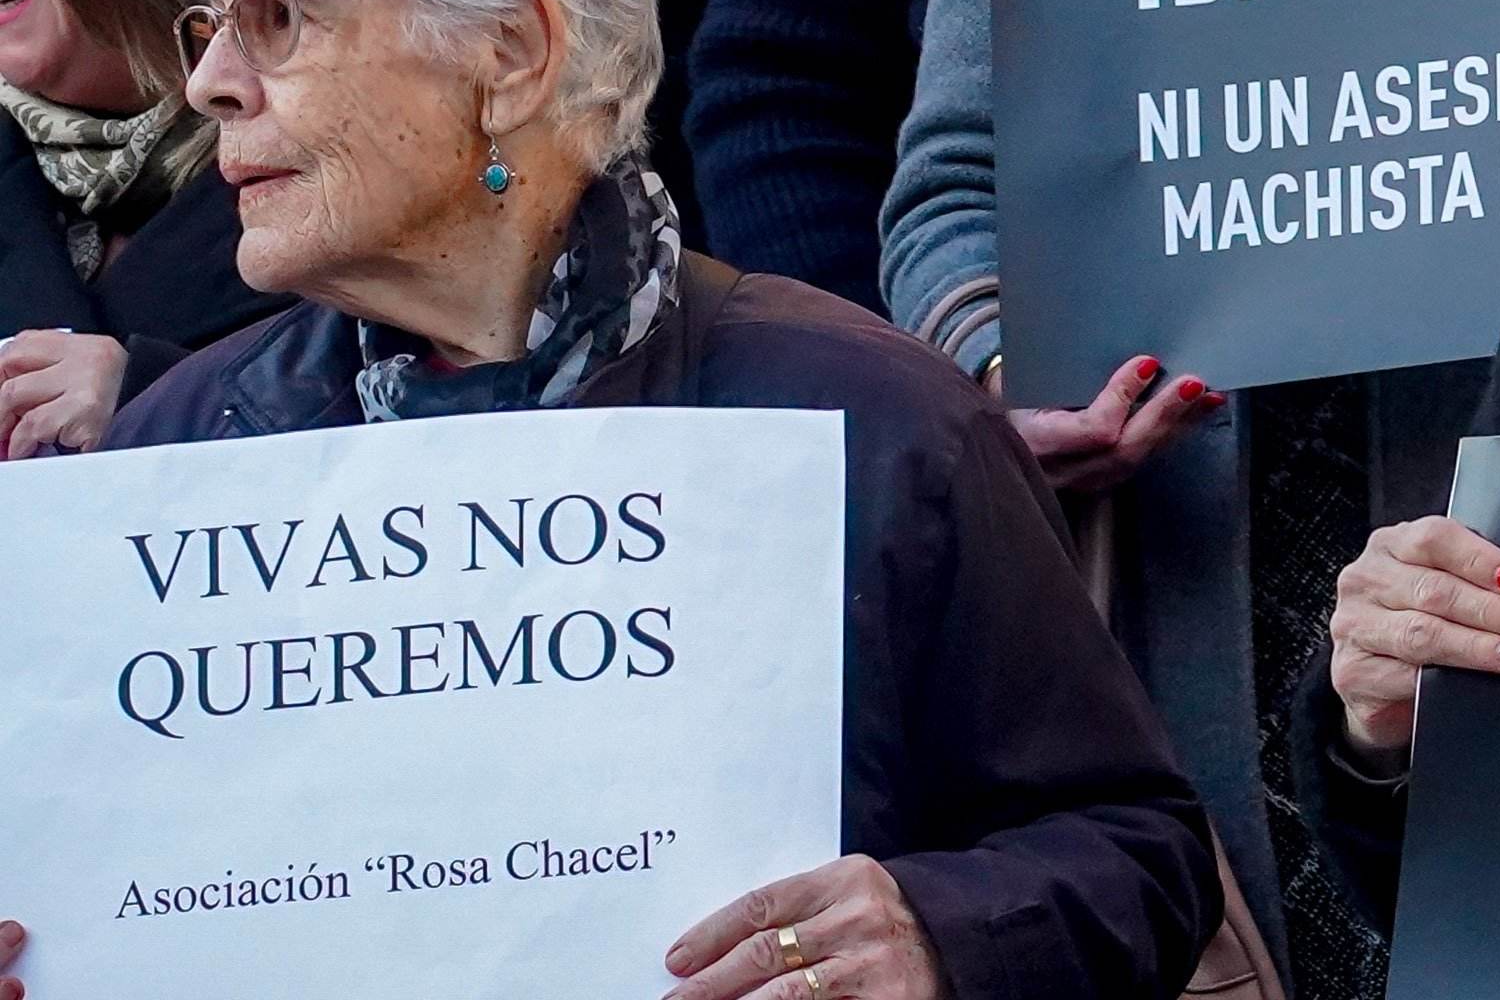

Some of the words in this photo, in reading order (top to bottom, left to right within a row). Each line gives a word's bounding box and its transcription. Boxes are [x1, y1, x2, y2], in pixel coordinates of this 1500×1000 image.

[1138, 88, 1201, 163] NI
[1224, 75, 1310, 154] UN
[1163, 150, 1484, 256] MACHISTA
[126, 504, 428, 604] VIVAS
[458, 491, 666, 573] NOS
[117, 606, 676, 739] QUEREMOS
[115, 861, 349, 919] Asociación
[364, 852, 490, 893] “Rosa
[507, 829, 677, 879] Chacel”
